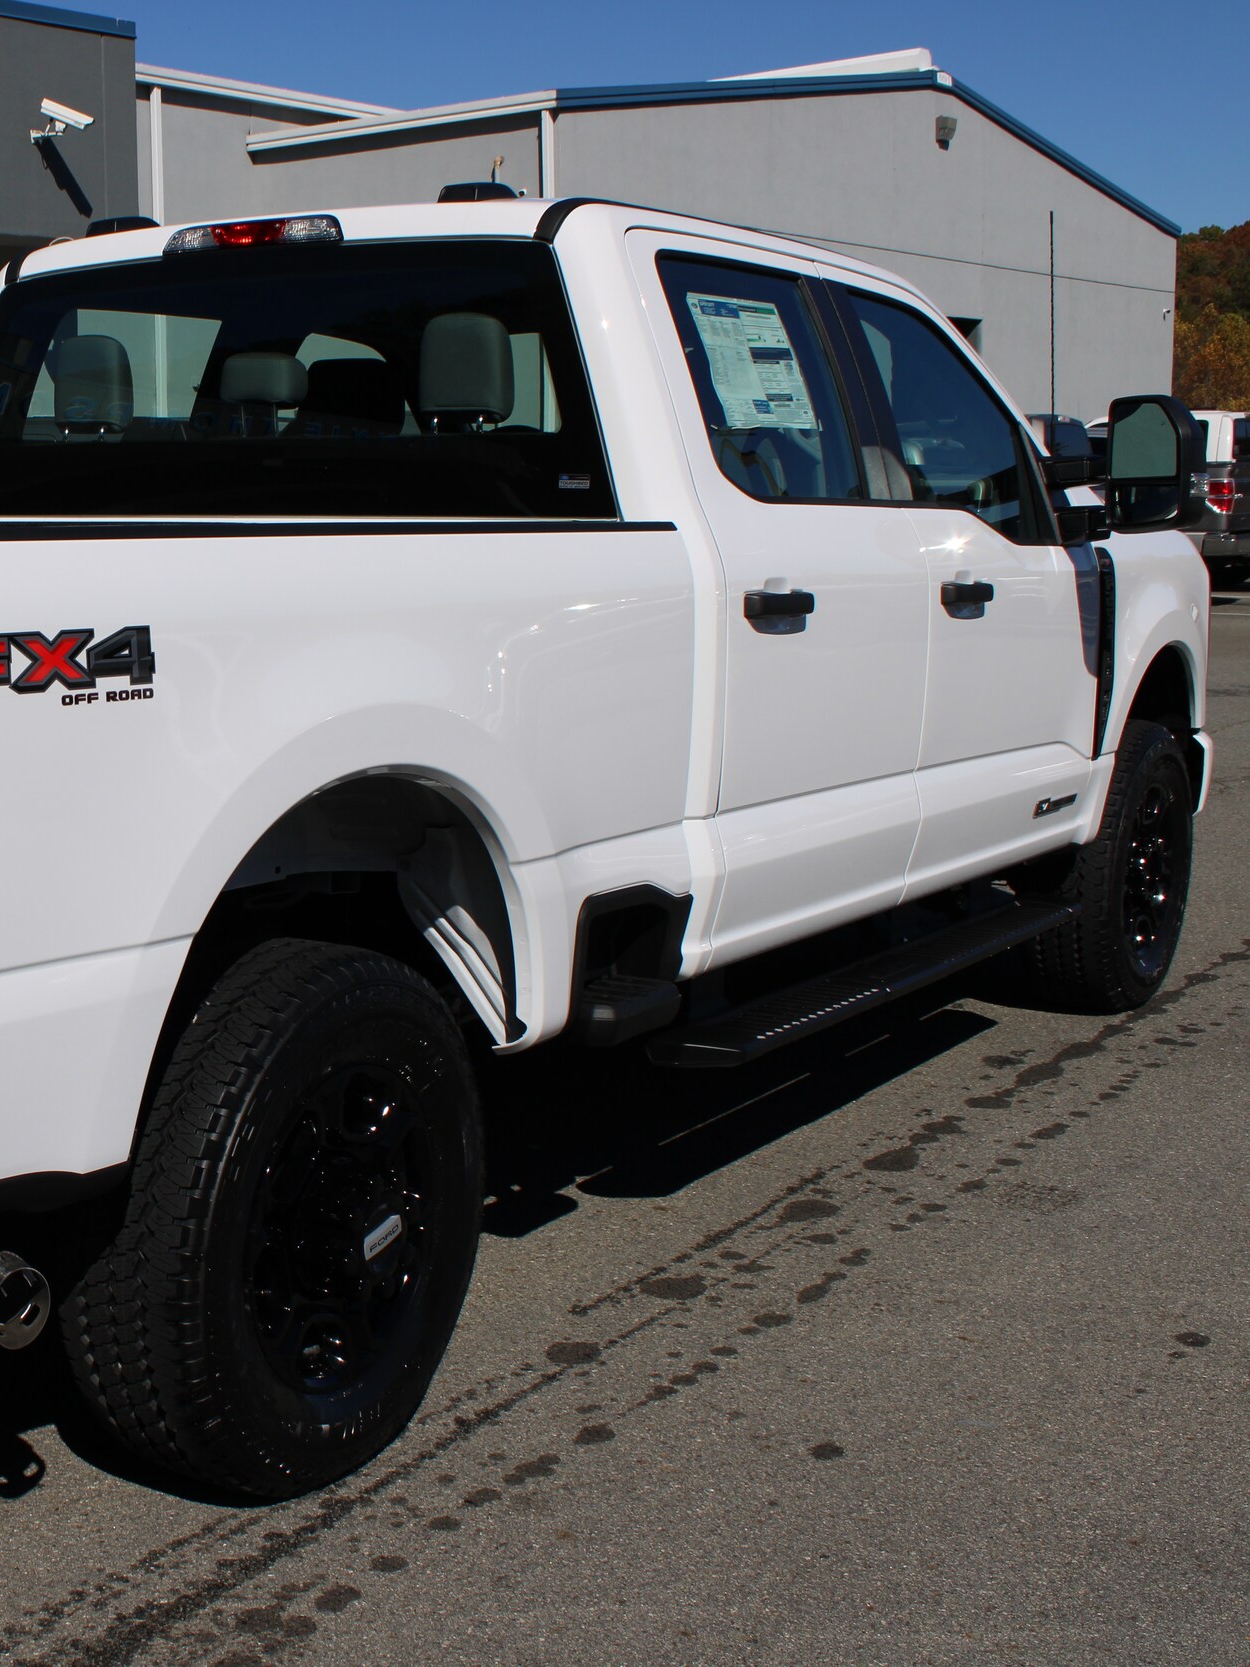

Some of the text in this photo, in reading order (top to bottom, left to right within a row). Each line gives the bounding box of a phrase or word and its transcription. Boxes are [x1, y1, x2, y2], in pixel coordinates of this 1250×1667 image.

[61, 687, 155, 706] OFF ROAD
[369, 1224, 399, 1253] FORD
